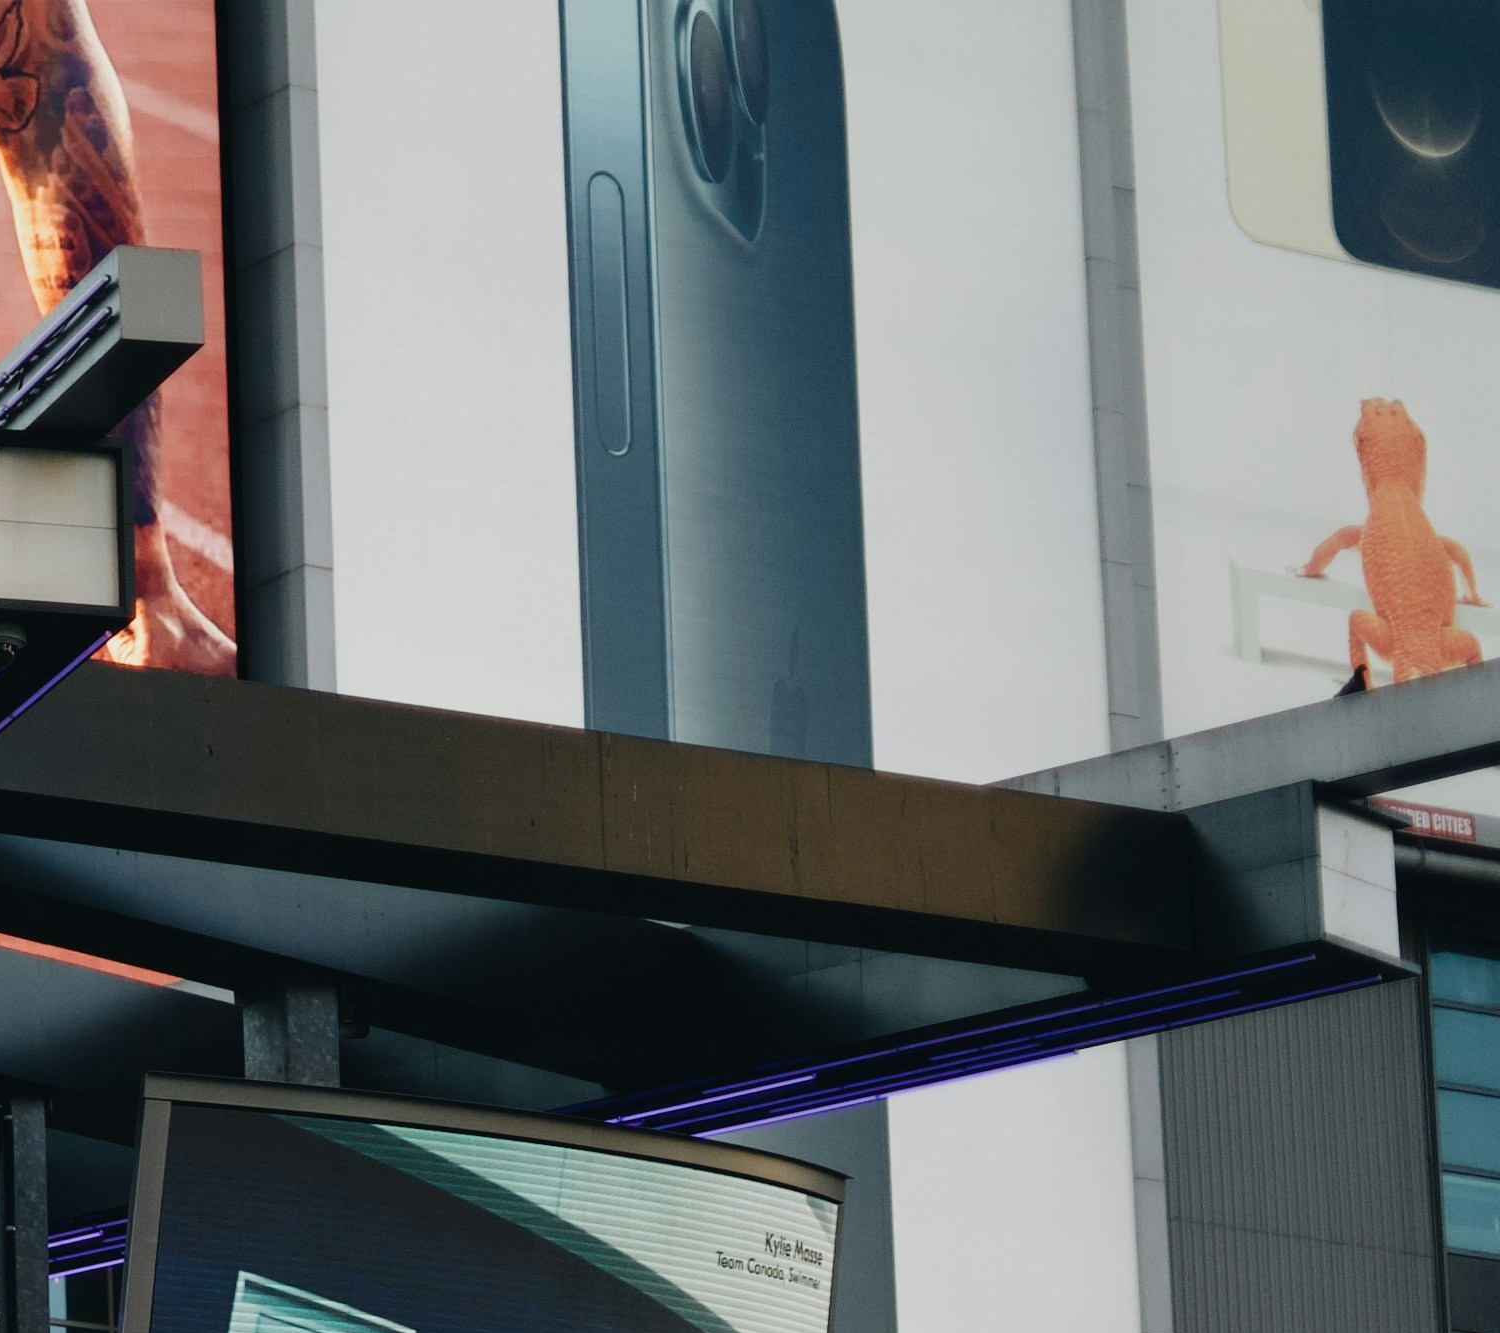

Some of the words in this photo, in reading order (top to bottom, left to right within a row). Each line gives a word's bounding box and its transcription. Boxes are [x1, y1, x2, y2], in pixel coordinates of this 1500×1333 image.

[716, 1251, 744, 1270] Team
[764, 1232, 792, 1258] Kylie
[793, 1239, 823, 1266] Masse
